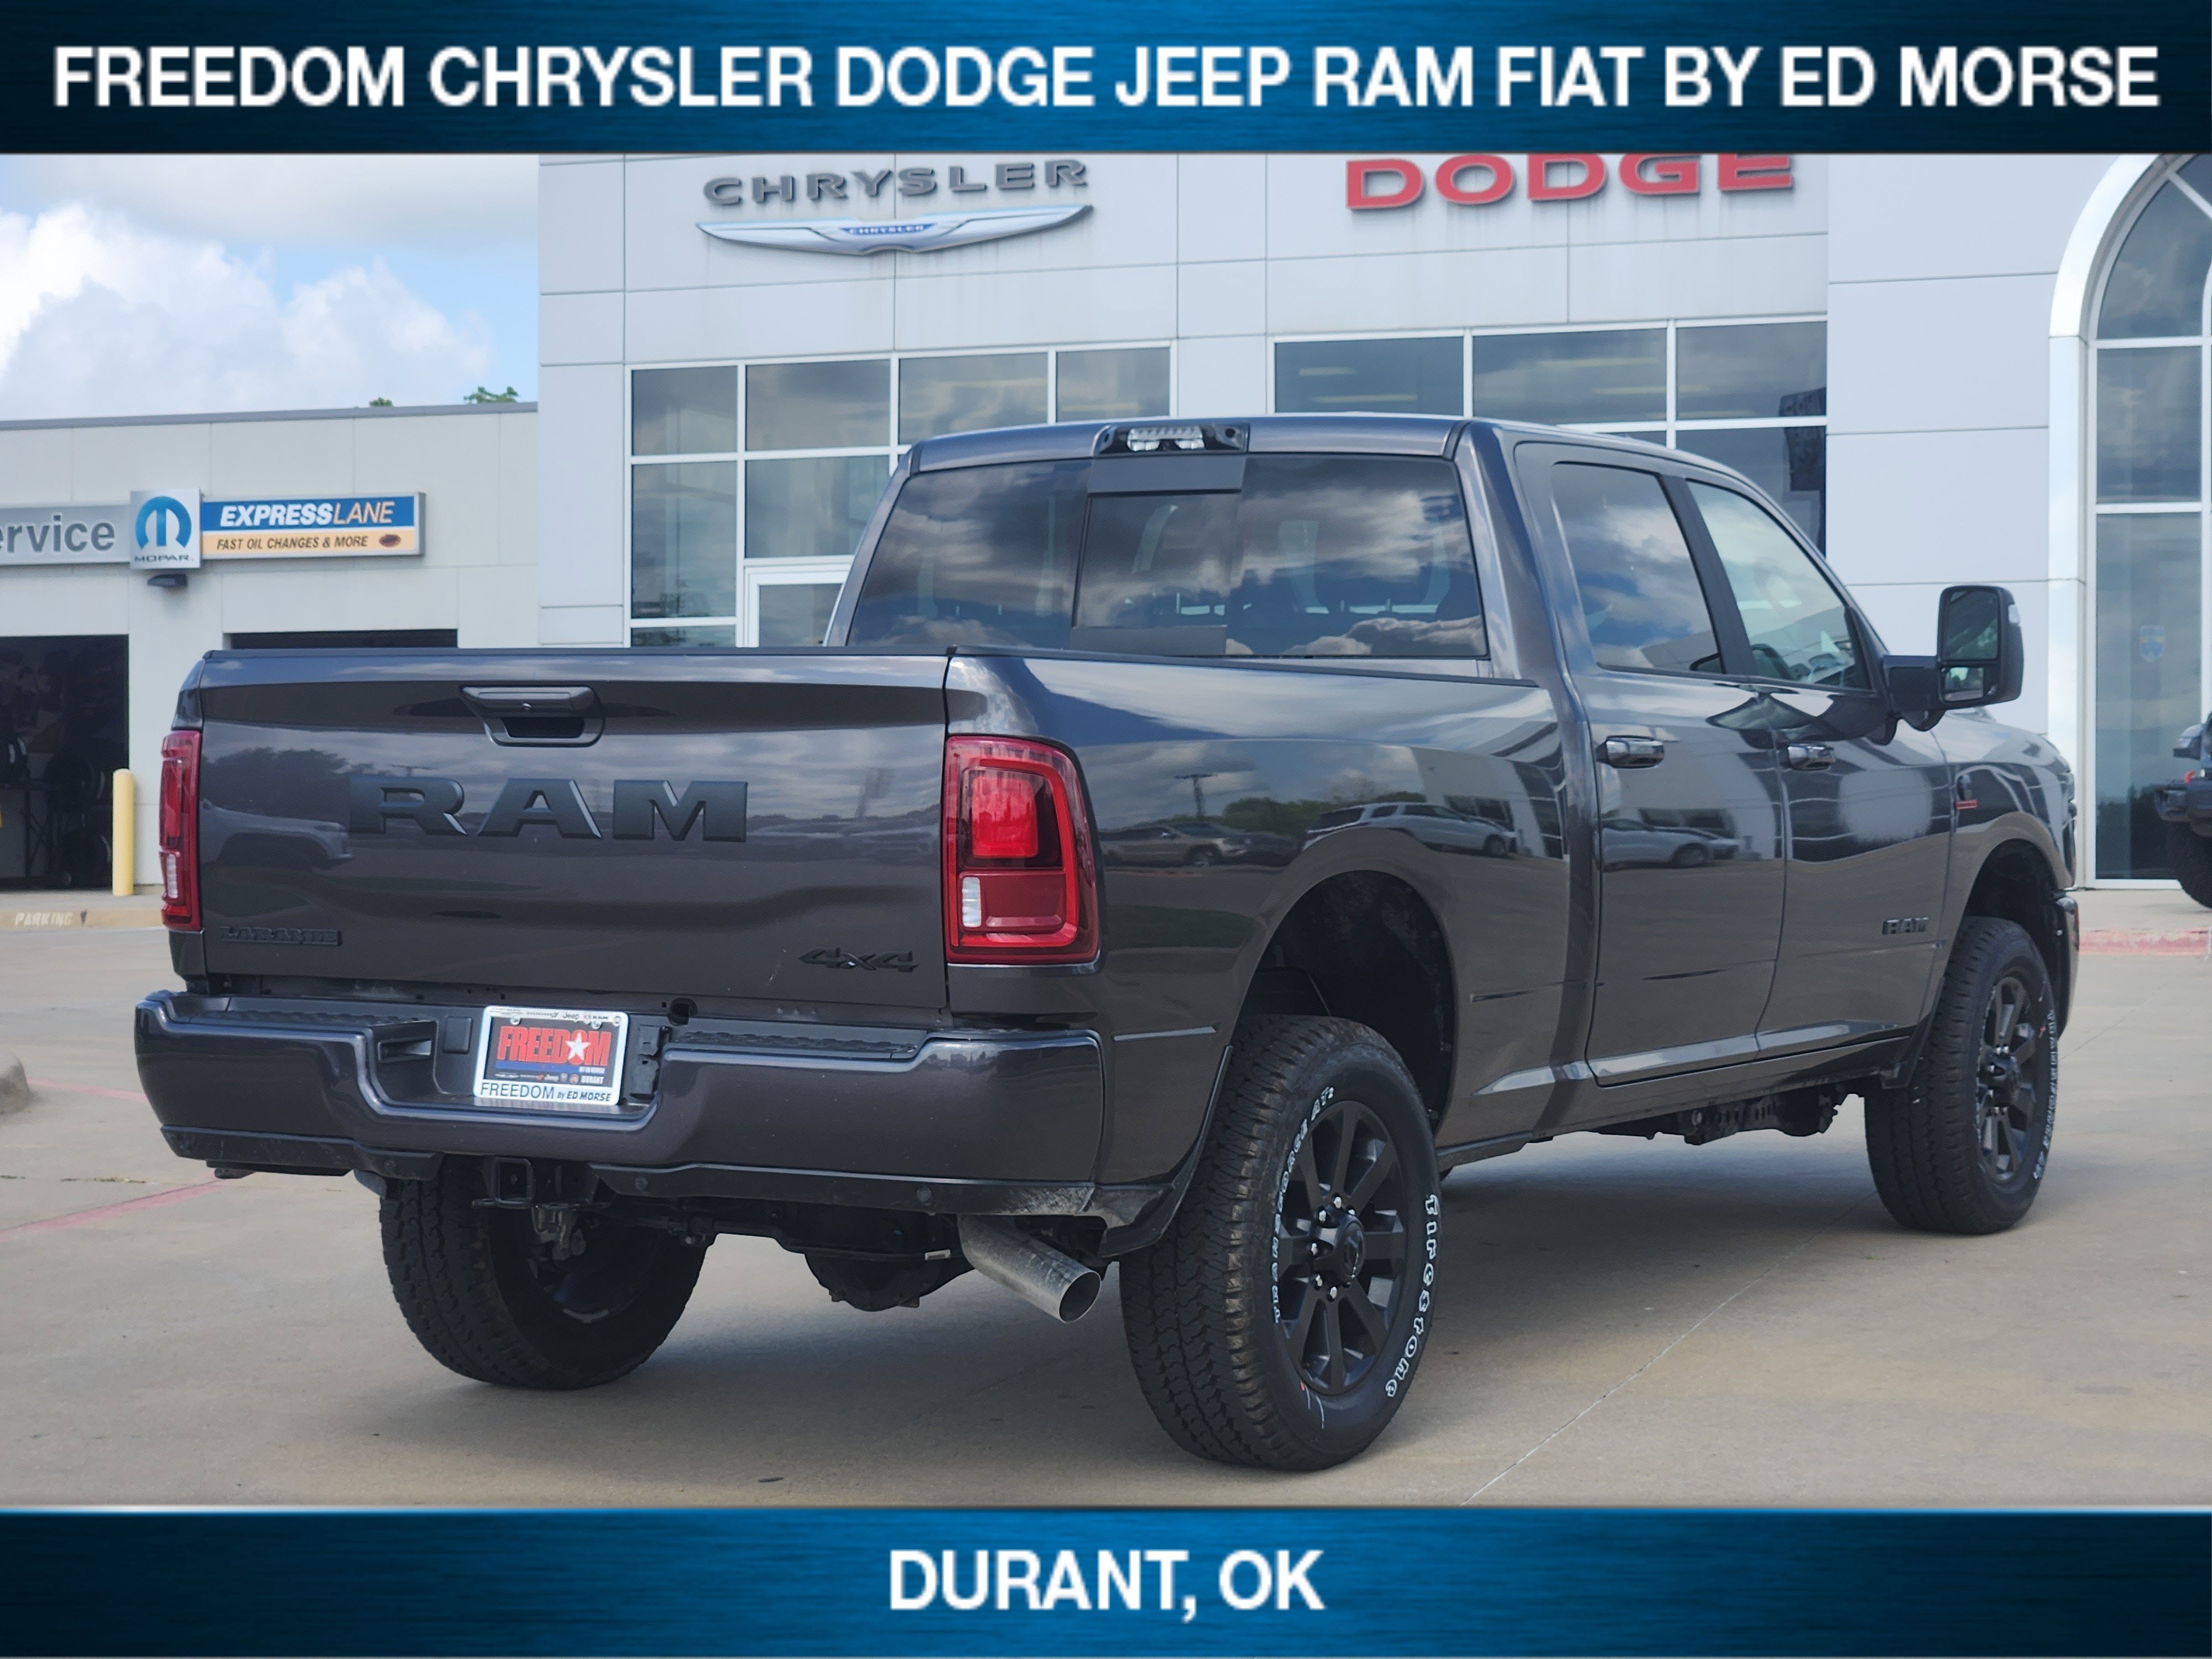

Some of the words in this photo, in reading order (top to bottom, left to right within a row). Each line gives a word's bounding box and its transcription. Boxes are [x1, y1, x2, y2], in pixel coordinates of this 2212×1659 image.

[703, 159, 1088, 205] CHRYSLER
[1346, 153, 1793, 210] DODGE
[0, 514, 116, 553] rvice
[216, 538, 243, 551] FAST
[247, 538, 262, 550] OIL
[267, 536, 319, 549] CHANGES
[322, 536, 330, 548] &
[334, 535, 369, 547] MORE
[134, 554, 189, 563] MOPAR
[348, 776, 748, 842] RAM
[14, 911, 72, 927] PARKING
[1882, 916, 1929, 935] RAM
[563, 1012, 580, 1021] Jeep
[497, 1025, 612, 1067] FREEDOM
[480, 1082, 554, 1099] FREEDOM
[566, 1091, 578, 1099] ED
[580, 1092, 612, 1102] MORSE
